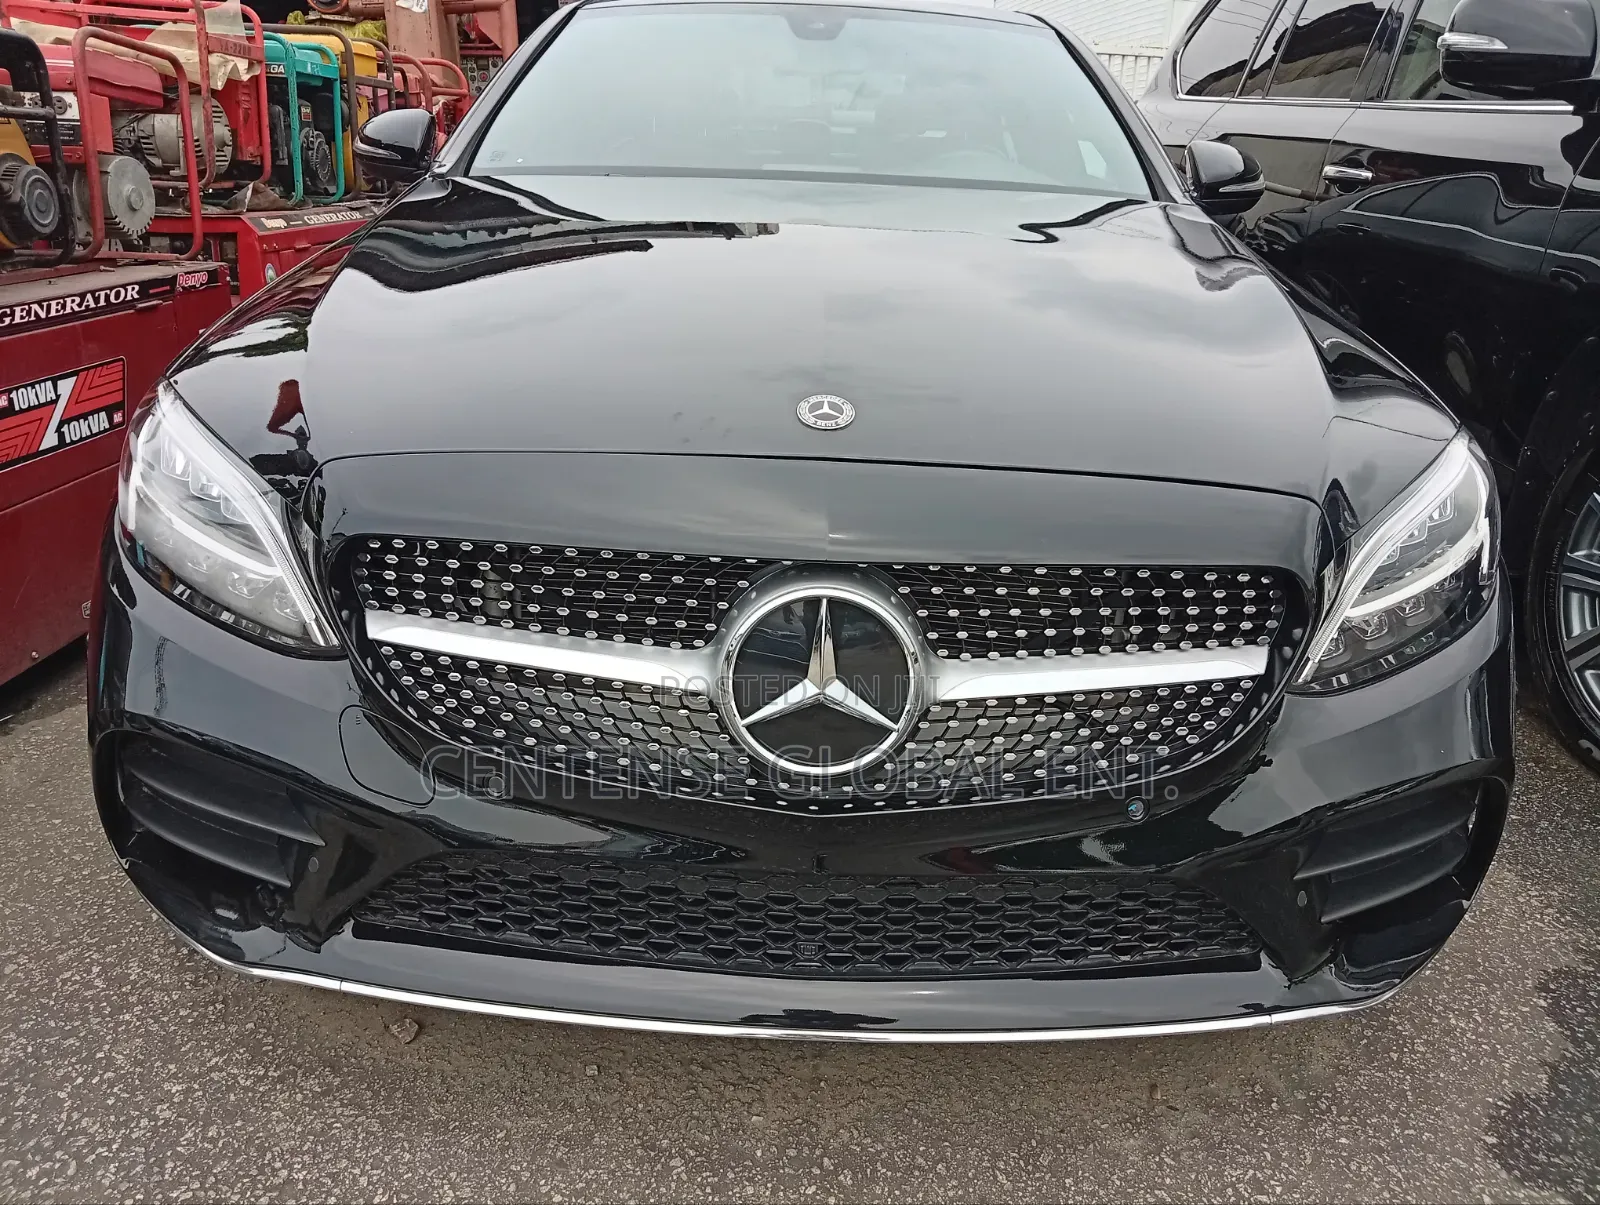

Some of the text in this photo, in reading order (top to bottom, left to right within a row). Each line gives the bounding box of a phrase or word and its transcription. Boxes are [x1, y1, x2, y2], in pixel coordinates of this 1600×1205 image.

[303, 211, 362, 225] GENERATOR
[0, 271, 208, 327] GENERATOR Denyo
[10, 380, 56, 411] 10kVA
[61, 411, 123, 443] 10kVA AC
